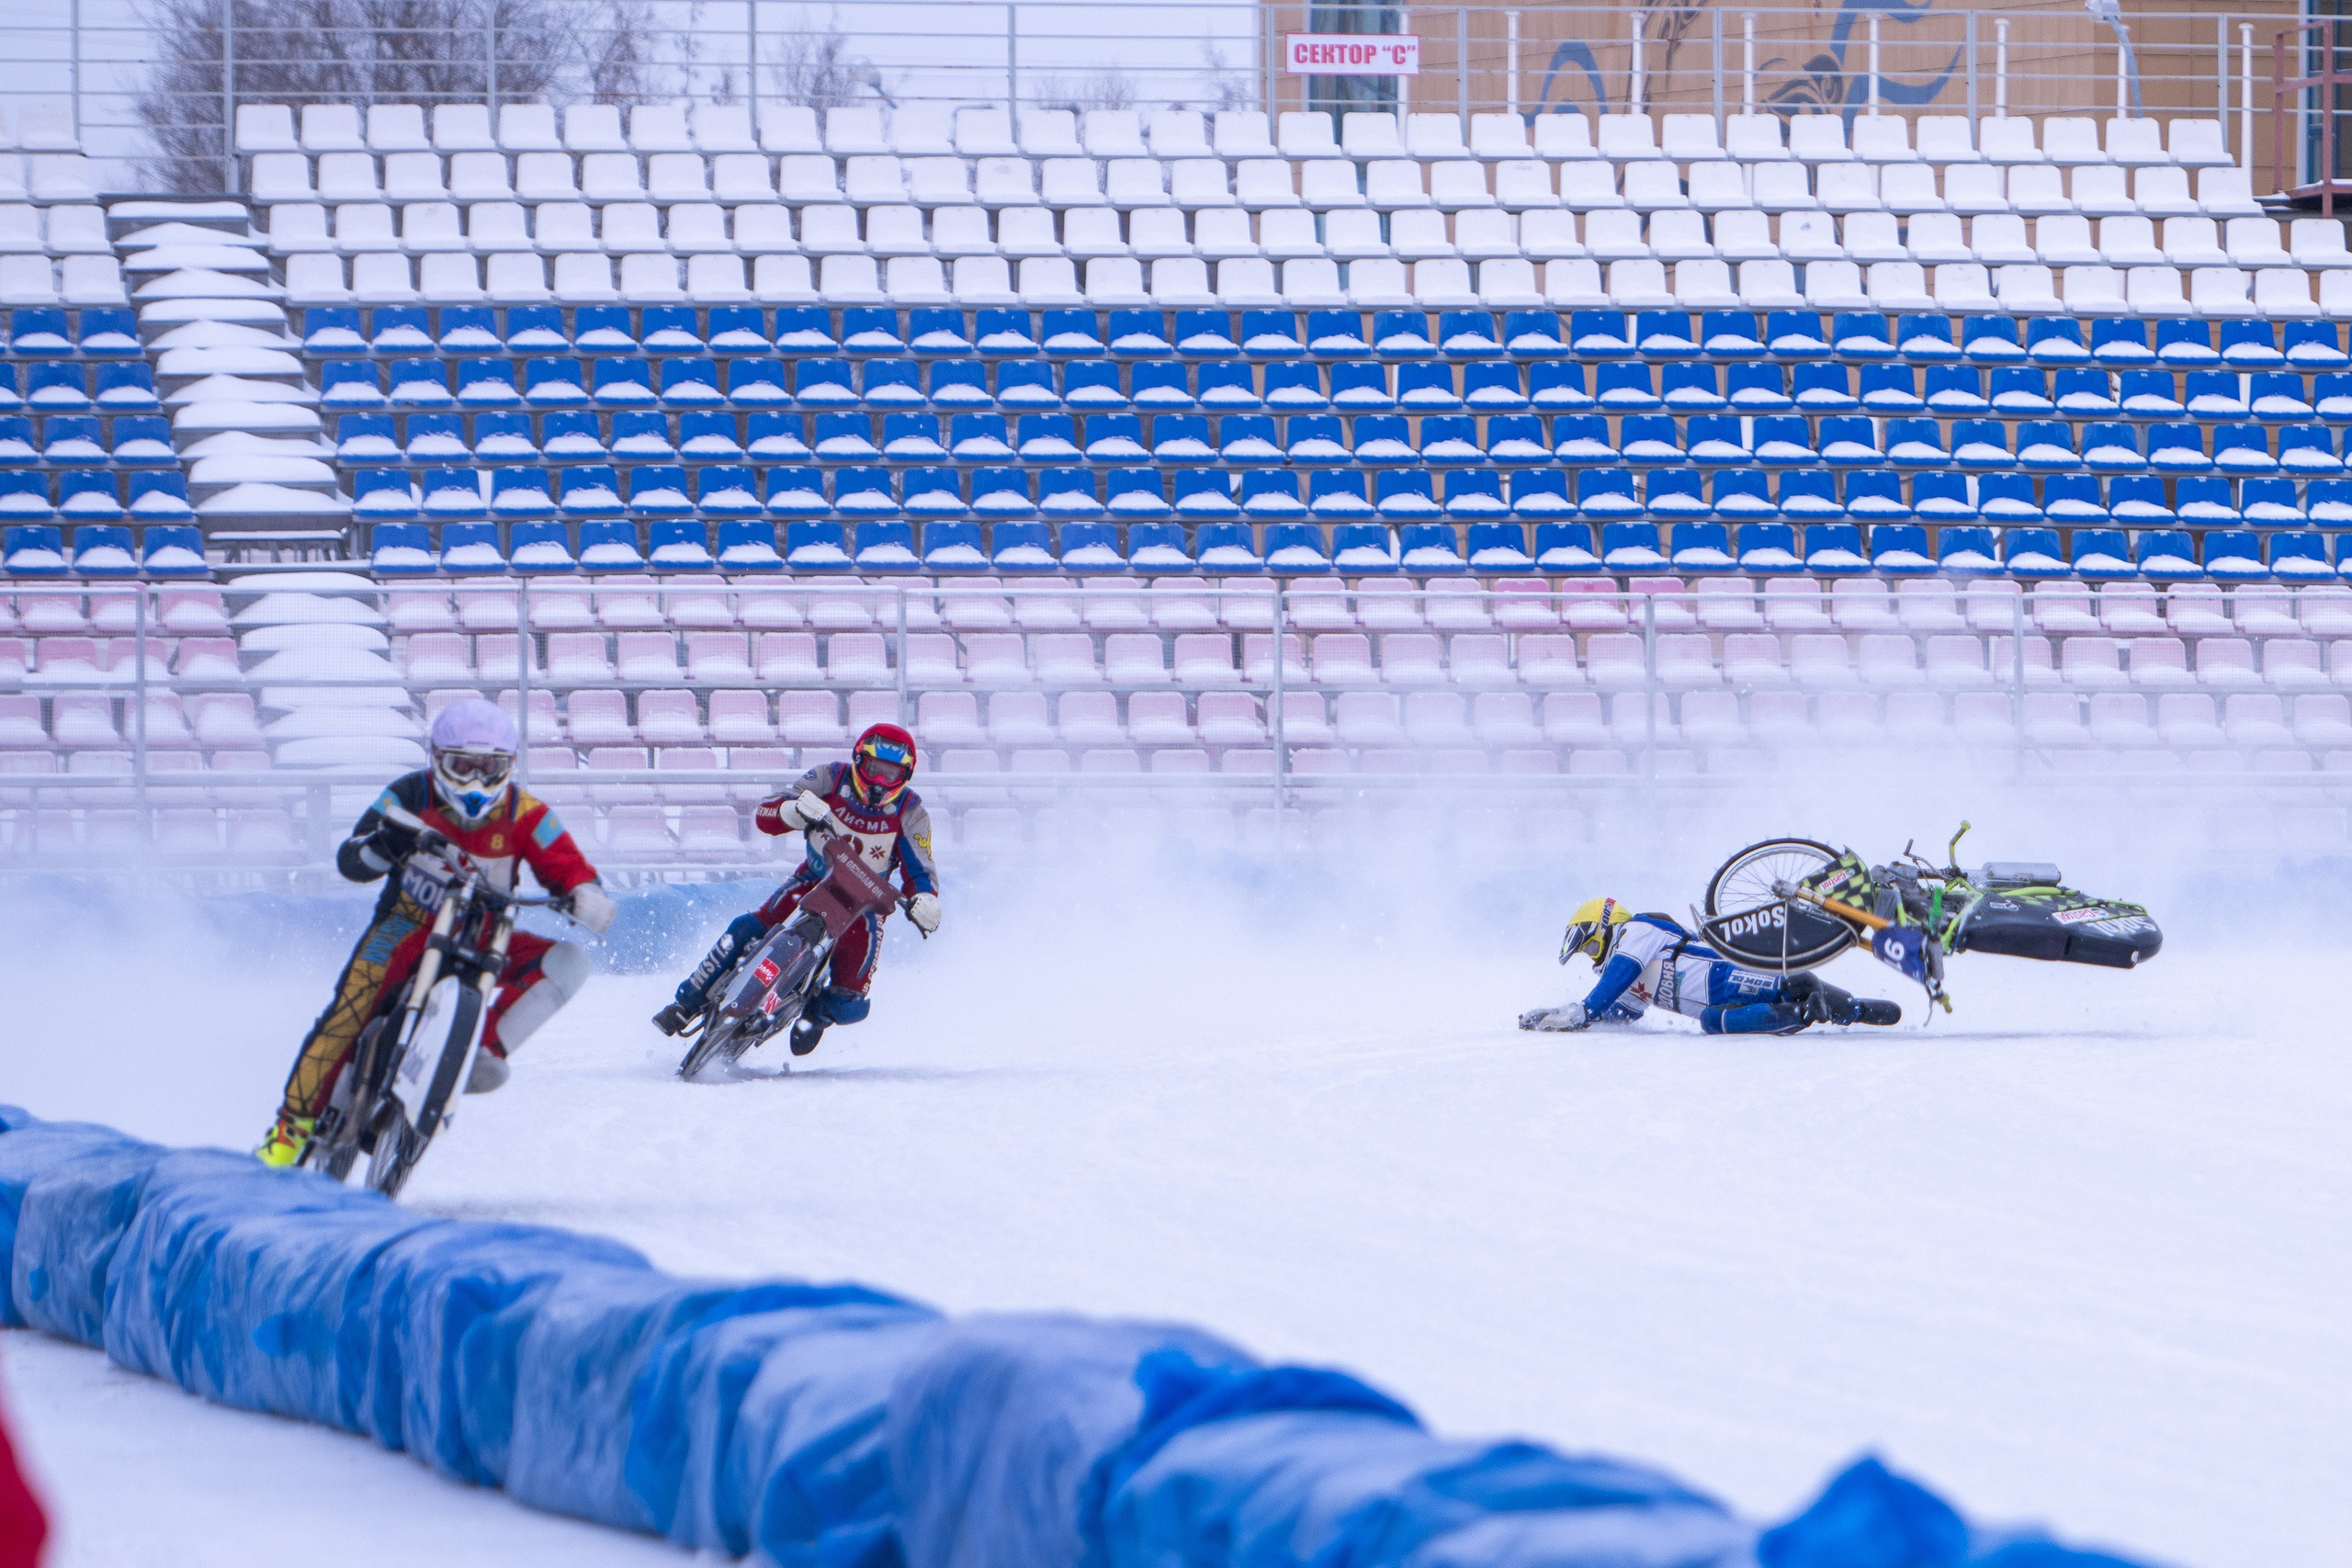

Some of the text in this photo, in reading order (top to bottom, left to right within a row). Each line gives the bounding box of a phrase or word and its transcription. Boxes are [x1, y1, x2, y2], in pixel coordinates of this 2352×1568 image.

[1294, 43, 1376, 64] СЕКТОР
[491, 833, 504, 850] 8
[837, 852, 849, 863] JB
[845, 860, 875, 889] GERMAN
[872, 886, 884, 899] OIL
[1822, 872, 1847, 890] Castrol
[2058, 908, 2096, 922] Castrol
